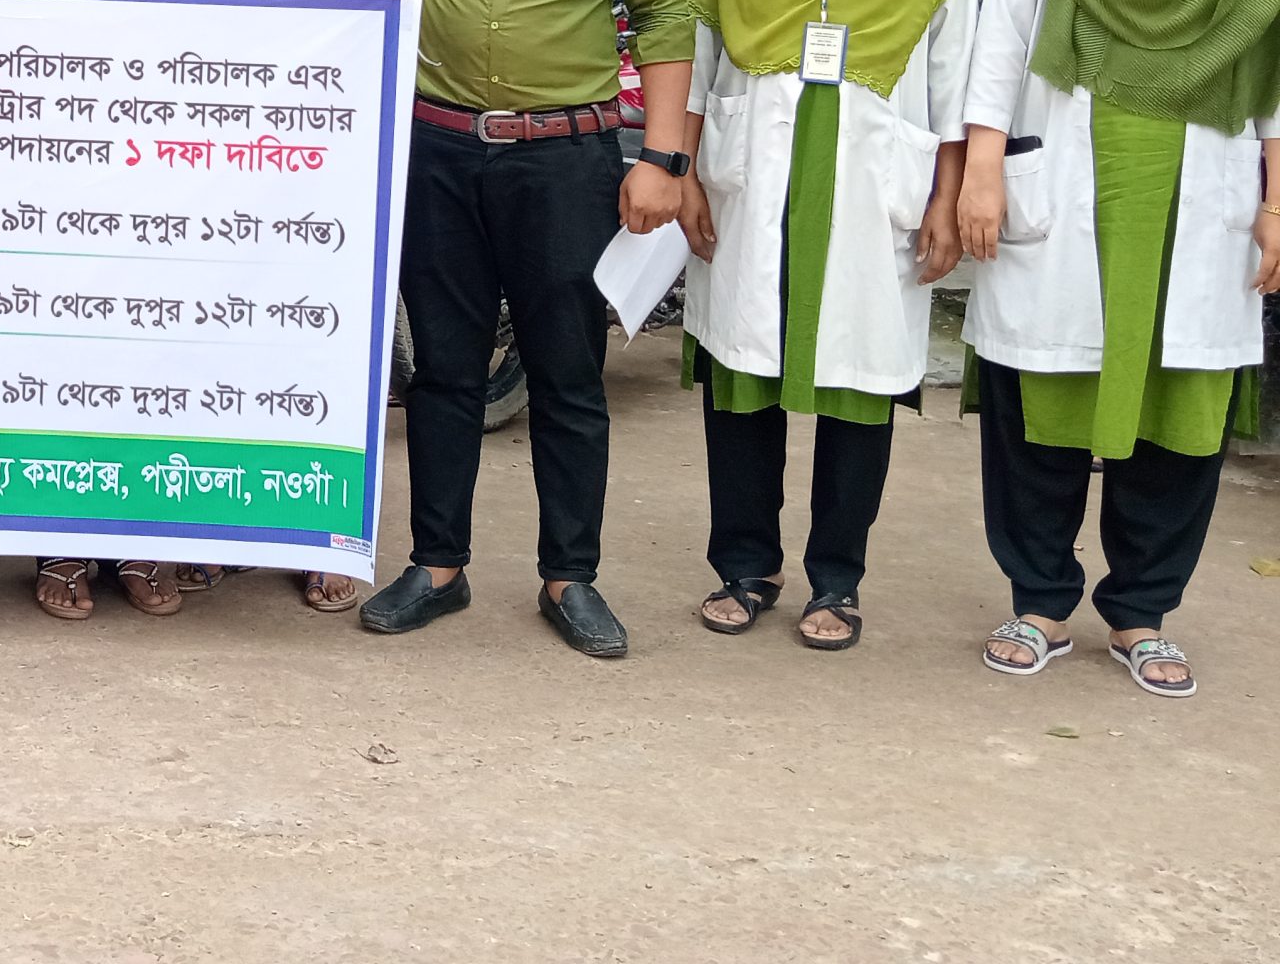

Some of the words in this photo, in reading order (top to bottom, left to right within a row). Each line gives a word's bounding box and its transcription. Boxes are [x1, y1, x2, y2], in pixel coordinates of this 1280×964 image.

[123, 60, 143, 80] ও
[158, 52, 277, 87] পরিচালক
[288, 66, 344, 92] এবং
[56, 96, 98, 122] পদ
[108, 97, 177, 124] থেকে
[185, 103, 254, 128] সকল
[262, 104, 356, 132] ক্যাডার
[126, 139, 141, 166] ১
[155, 140, 215, 169] দফা
[224, 135, 327, 172] দাবিতে
[2, 201, 47, 233] ৯টা
[57, 209, 122, 235] থেকে
[130, 214, 189, 245] দুপুর
[201, 212, 262, 244] ১২টা
[273, 212, 344, 252] পর্যন্ত)
[51, 293, 117, 319] থেকে
[124, 297, 184, 329] দুপুর
[195, 296, 256, 328] ১২টা
[267, 296, 339, 336] পর্যন্ত)
[3, 373, 47, 405] ৯টা
[58, 382, 124, 408] থেকে
[131, 386, 190, 417] দুপুর
[201, 382, 246, 416] ২টা
[256, 384, 328, 425] পর্যন্ত)
[21, 459, 128, 499] কমপ্লেক্স,
[142, 453, 251, 504] পত্নীতলা,
[262, 462, 333, 503] নওগাঁ
